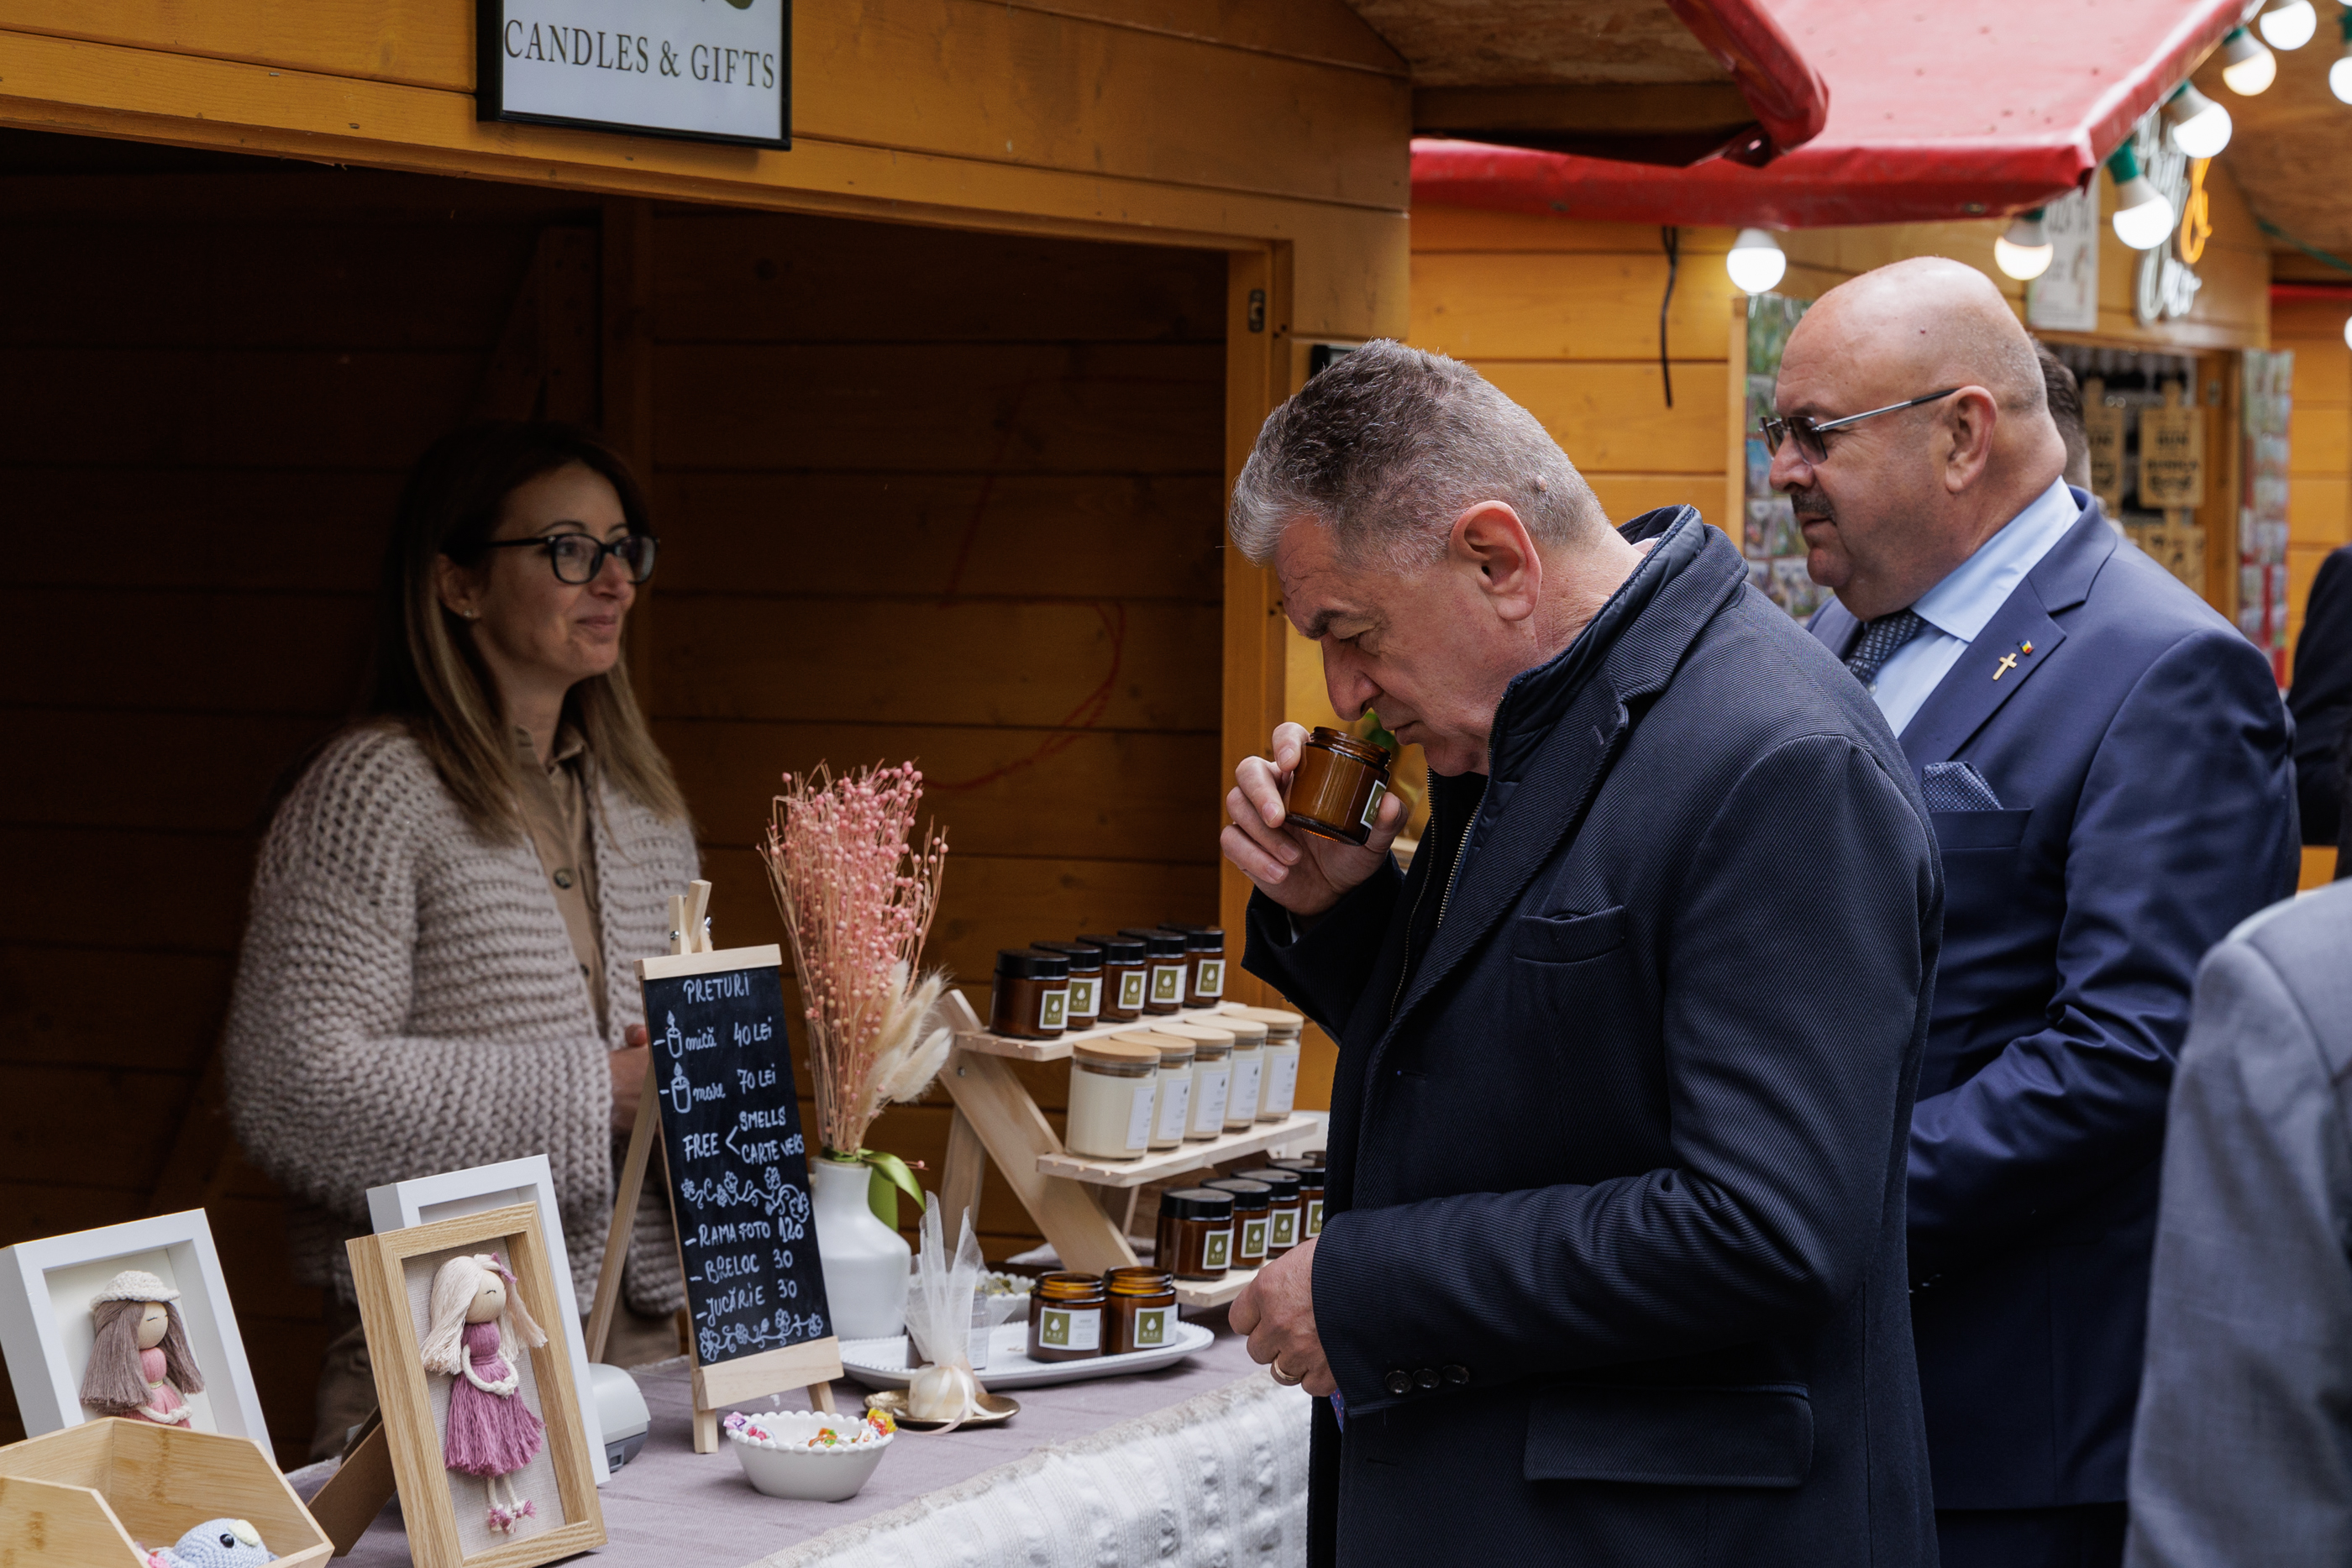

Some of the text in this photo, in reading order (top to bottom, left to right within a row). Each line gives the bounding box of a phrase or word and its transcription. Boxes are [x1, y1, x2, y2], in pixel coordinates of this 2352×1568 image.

[505, 19, 775, 89] CANDLES & GIFTS
[685, 1026, 717, 1051] mică
[733, 1022, 751, 1046] 40
[692, 1083, 726, 1102] mare
[737, 1068, 755, 1094] 70
[739, 1105, 786, 1131] SMELLS
[683, 1132, 721, 1162] FREE
[741, 1140, 780, 1165] CARTE
[698, 1223, 738, 1248] RAMA
[738, 1220, 771, 1241] FOTO
[778, 1217, 805, 1243] 120
[705, 1254, 760, 1284] BRELOC
[773, 1249, 793, 1269] 30
[777, 1279, 797, 1298] 30
